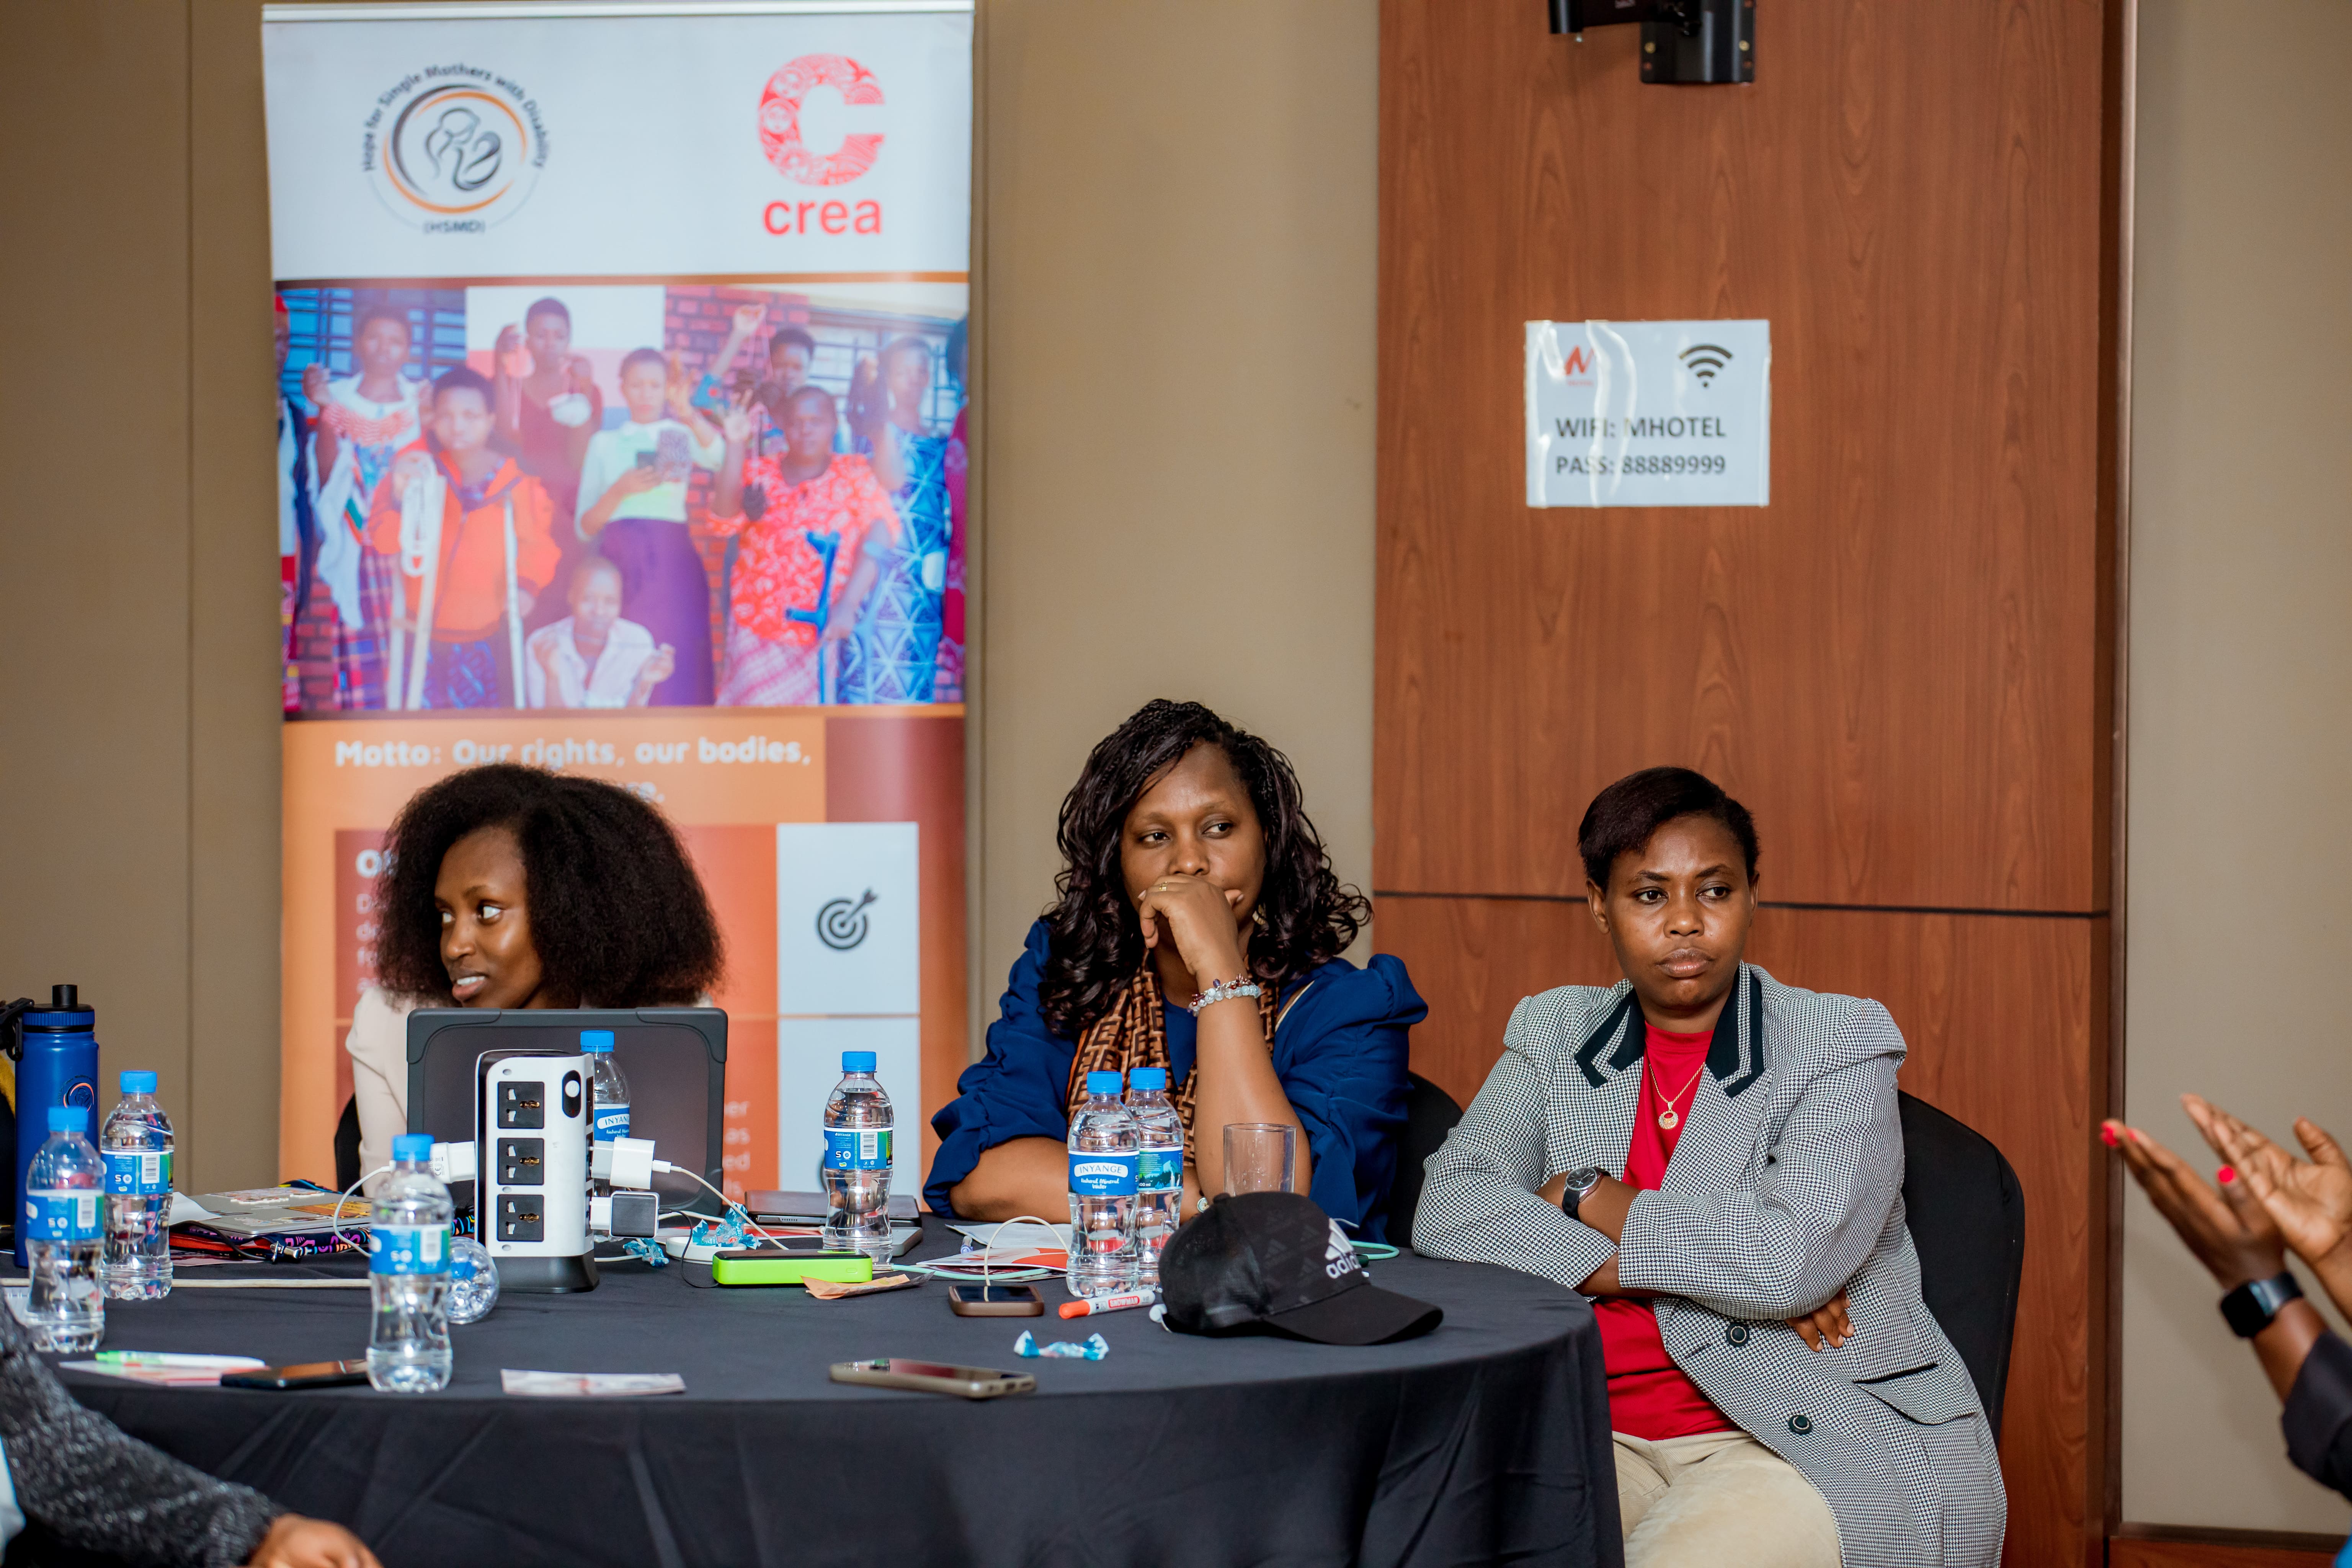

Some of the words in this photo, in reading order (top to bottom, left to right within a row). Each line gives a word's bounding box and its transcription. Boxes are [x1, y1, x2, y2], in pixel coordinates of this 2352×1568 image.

[425, 63, 492, 80] Mothers
[496, 77, 525, 101] with
[764, 200, 882, 235] crea
[1624, 417, 1726, 437] MHOTEL
[1623, 456, 1725, 474] 88889999
[335, 740, 441, 766] Motto:
[453, 739, 513, 765] Our
[522, 737, 624, 769] rights,
[635, 742, 690, 763] our
[699, 735, 811, 766] bodies,
[1080, 1165, 1122, 1174] INYANGE
